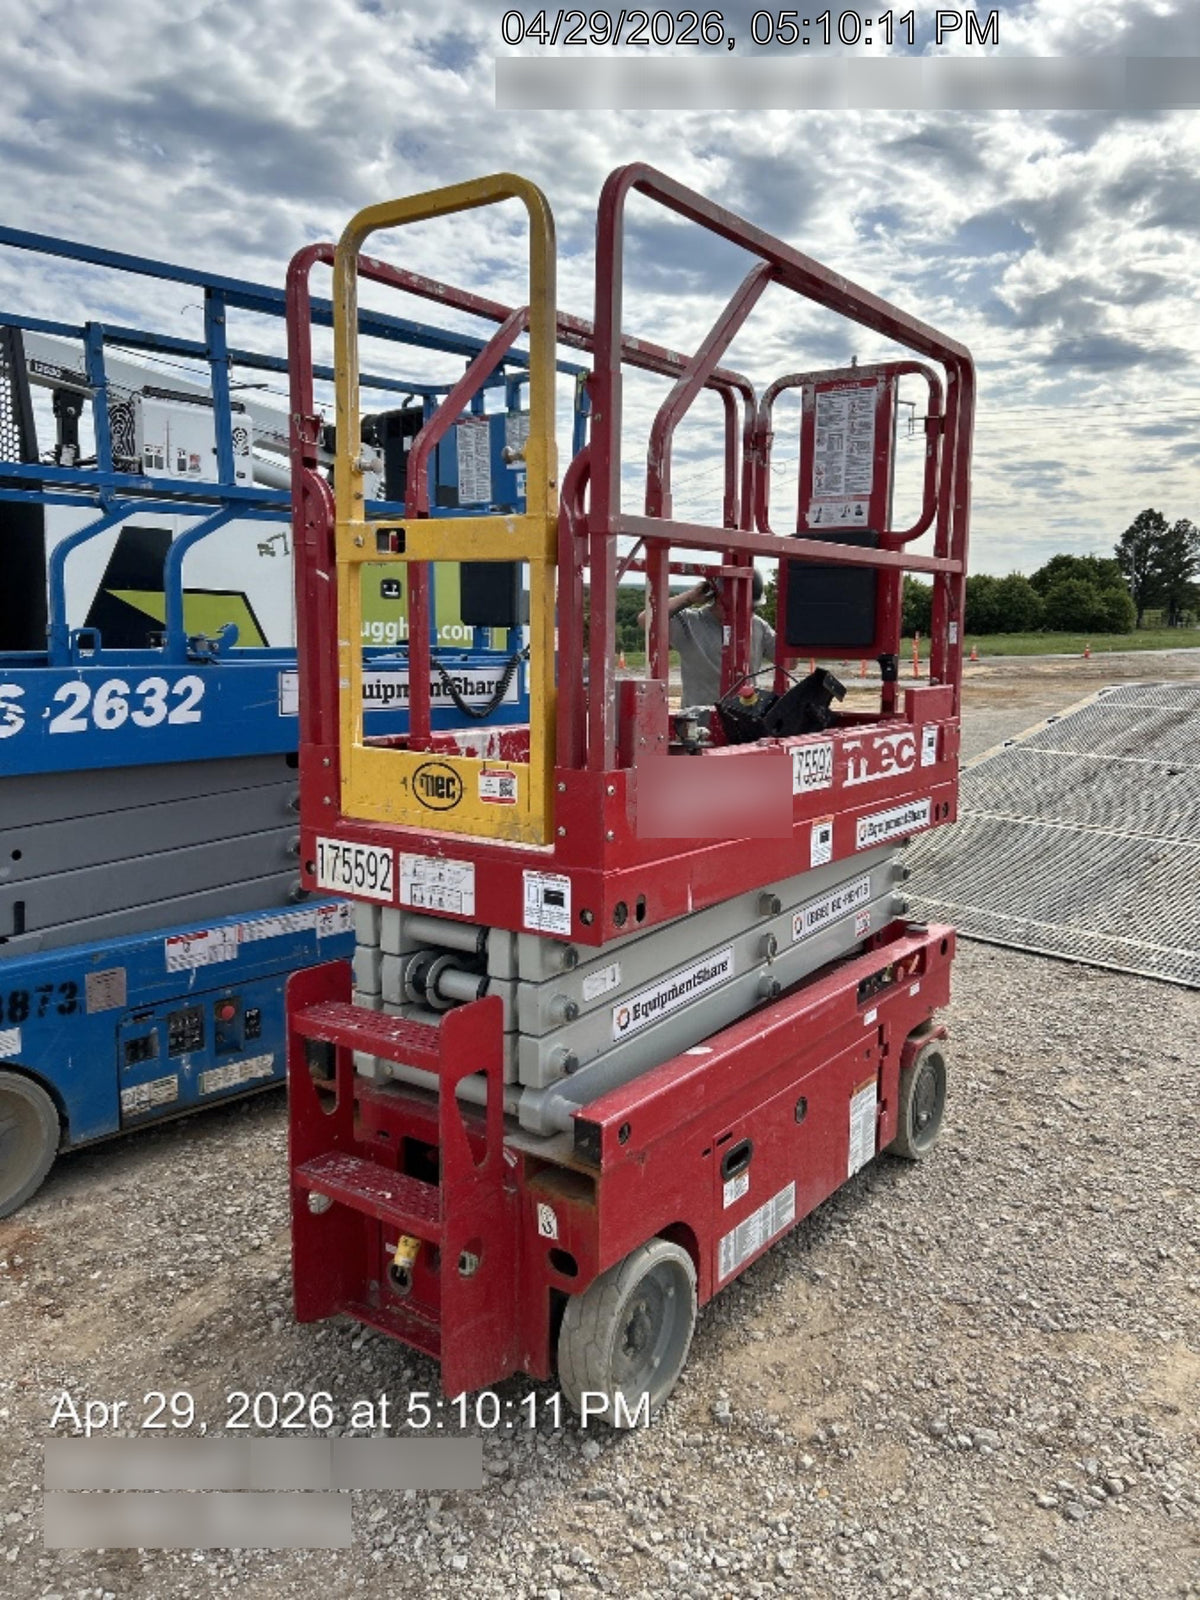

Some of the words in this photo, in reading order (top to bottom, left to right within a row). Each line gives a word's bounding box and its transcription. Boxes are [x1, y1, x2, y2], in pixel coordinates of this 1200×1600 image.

[49, 674, 206, 735] 2632
[316, 842, 393, 893] 175592
[0, 980, 78, 1024] 873
[632, 959, 729, 1021] EquipmentShare
